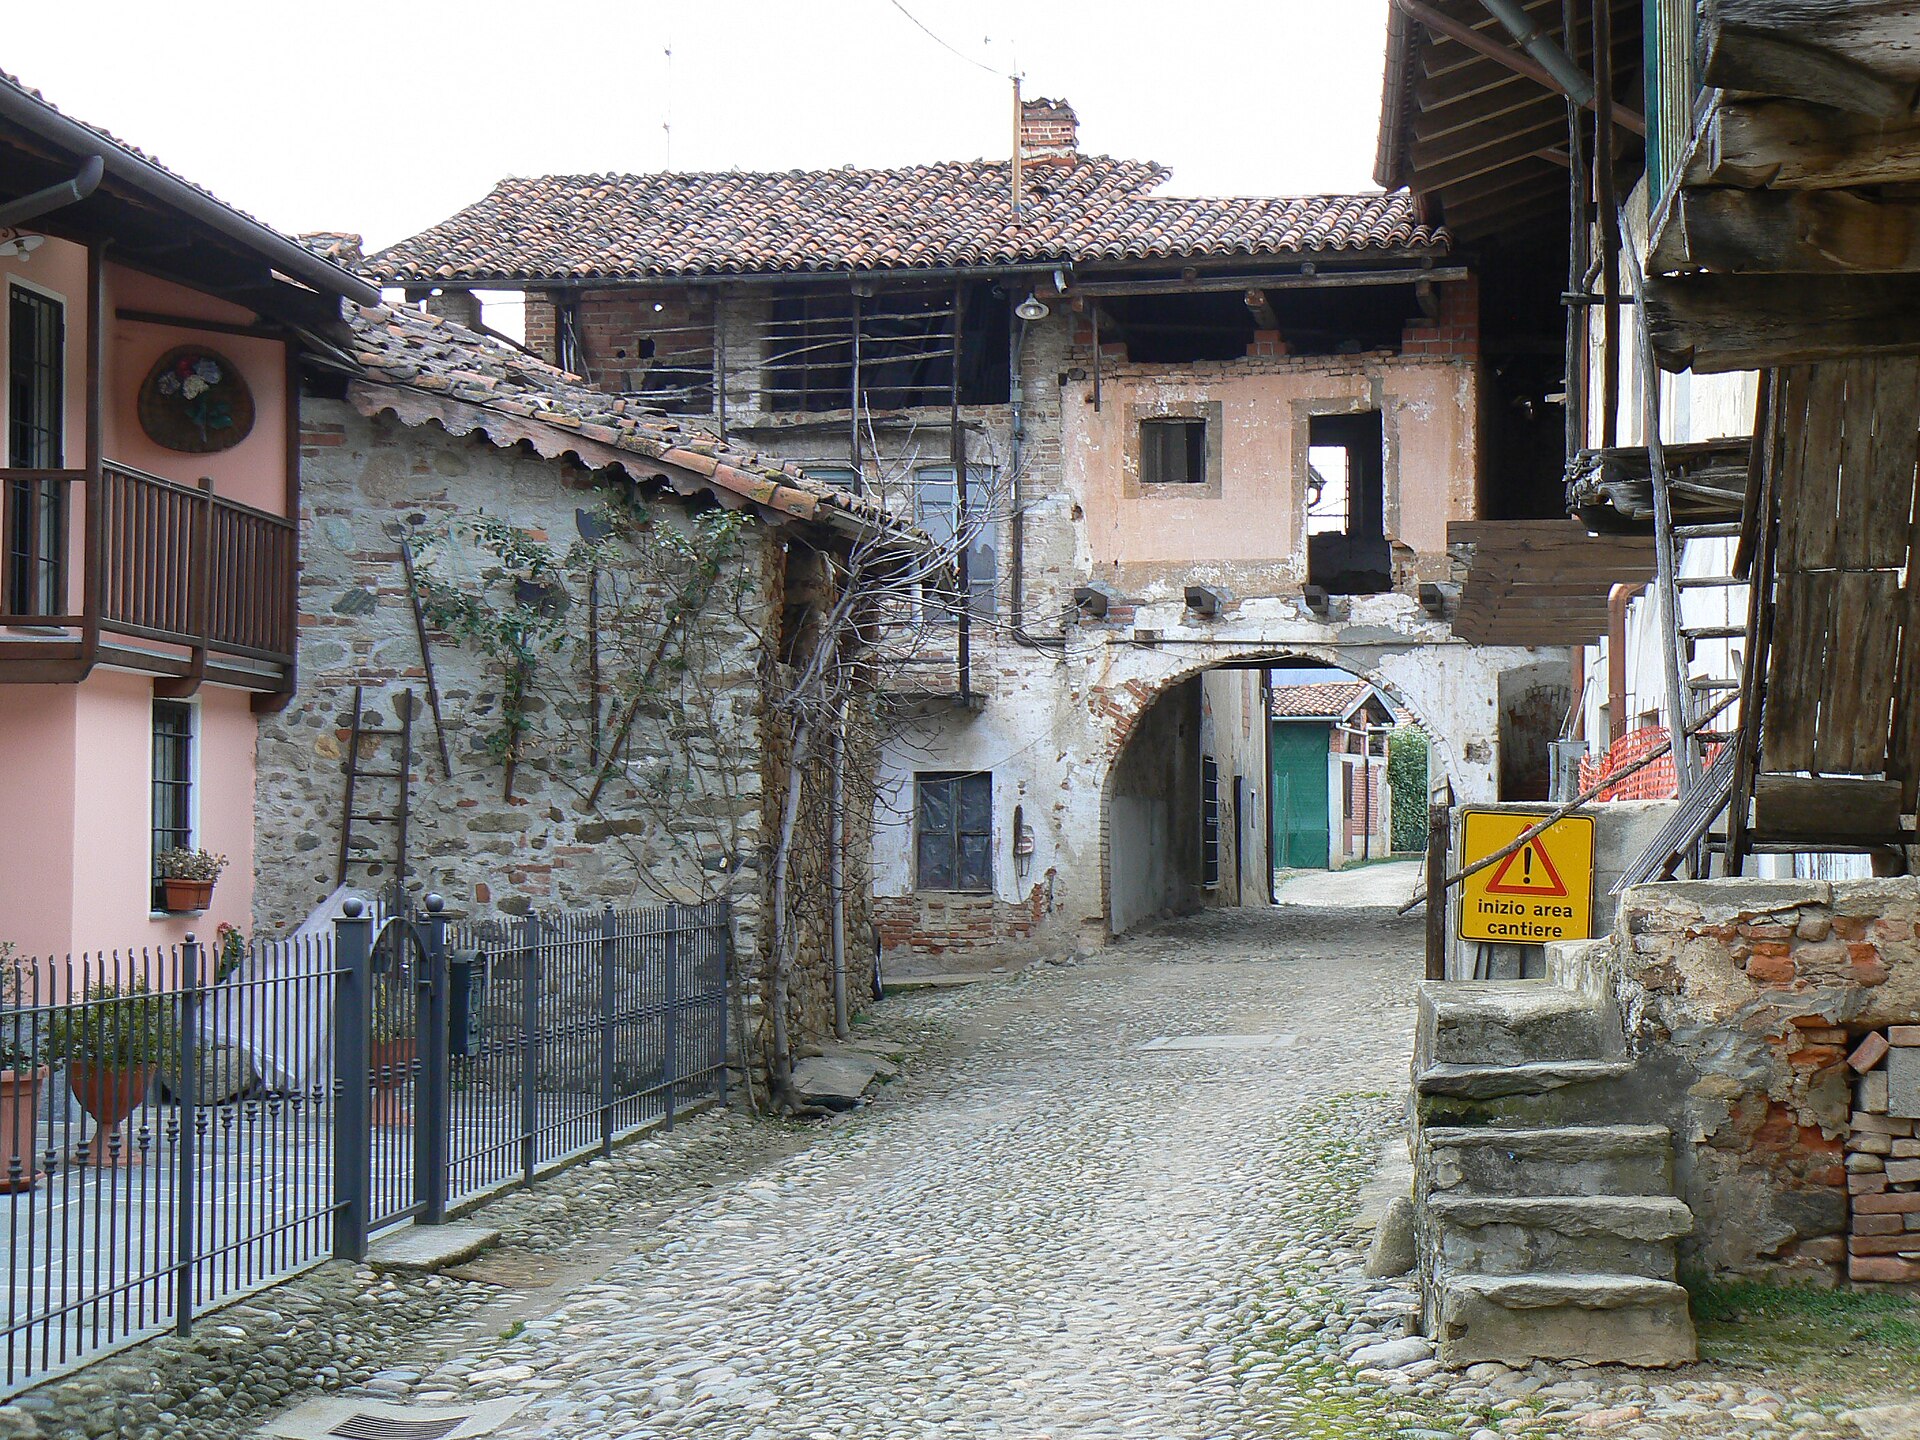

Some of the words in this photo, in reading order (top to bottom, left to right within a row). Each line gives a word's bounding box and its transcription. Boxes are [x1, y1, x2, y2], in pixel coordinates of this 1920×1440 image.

[1478, 899, 1525, 915] inizio
[1533, 905, 1573, 918] area
[1487, 922, 1562, 937] cantiere
